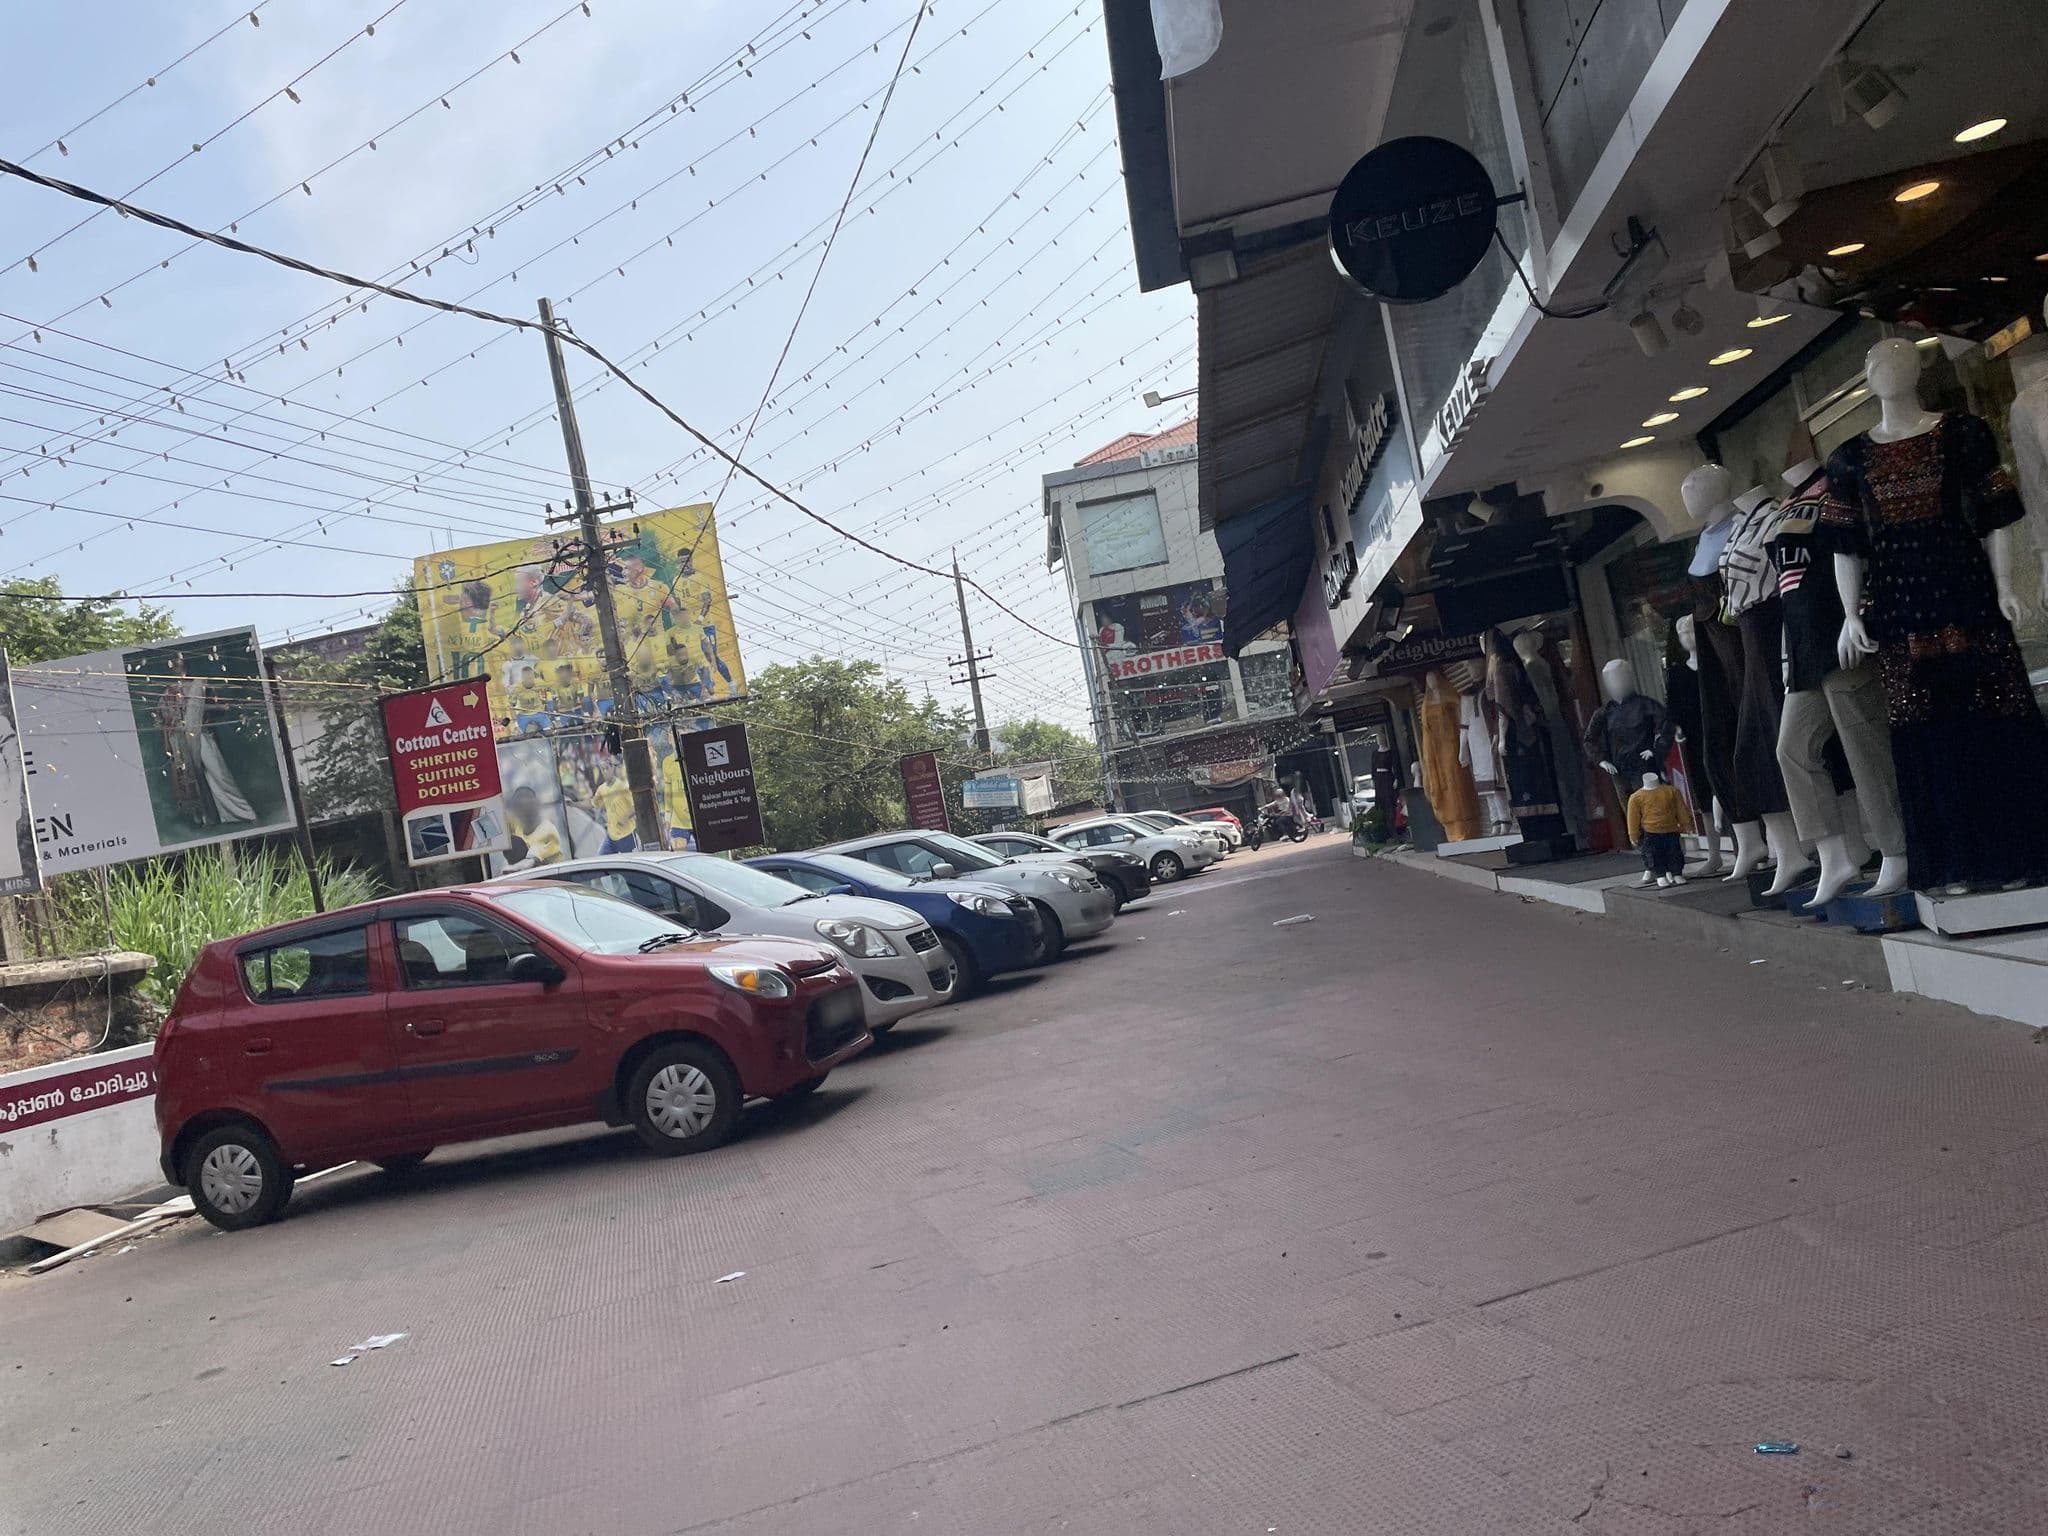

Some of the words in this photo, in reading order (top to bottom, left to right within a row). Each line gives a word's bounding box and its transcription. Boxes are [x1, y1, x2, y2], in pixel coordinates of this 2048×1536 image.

[1345, 191, 1482, 247] KEUZE
[1432, 361, 1480, 455] KEUZE
[1357, 391, 1388, 472] Centre
[1110, 643, 1225, 679] BROTHERS
[395, 734, 441, 754] Cotton
[442, 725, 488, 744] Centre
[409, 748, 479, 770] SHIRTING
[416, 764, 476, 784] SUITING
[690, 767, 751, 786] Neighbours
[417, 778, 481, 799] DOTHIES
[698, 798, 733, 809] Readymade
[43, 851, 53, 861] &
[58, 835, 129, 859] Materials
[4, 877, 32, 891] KIDS
